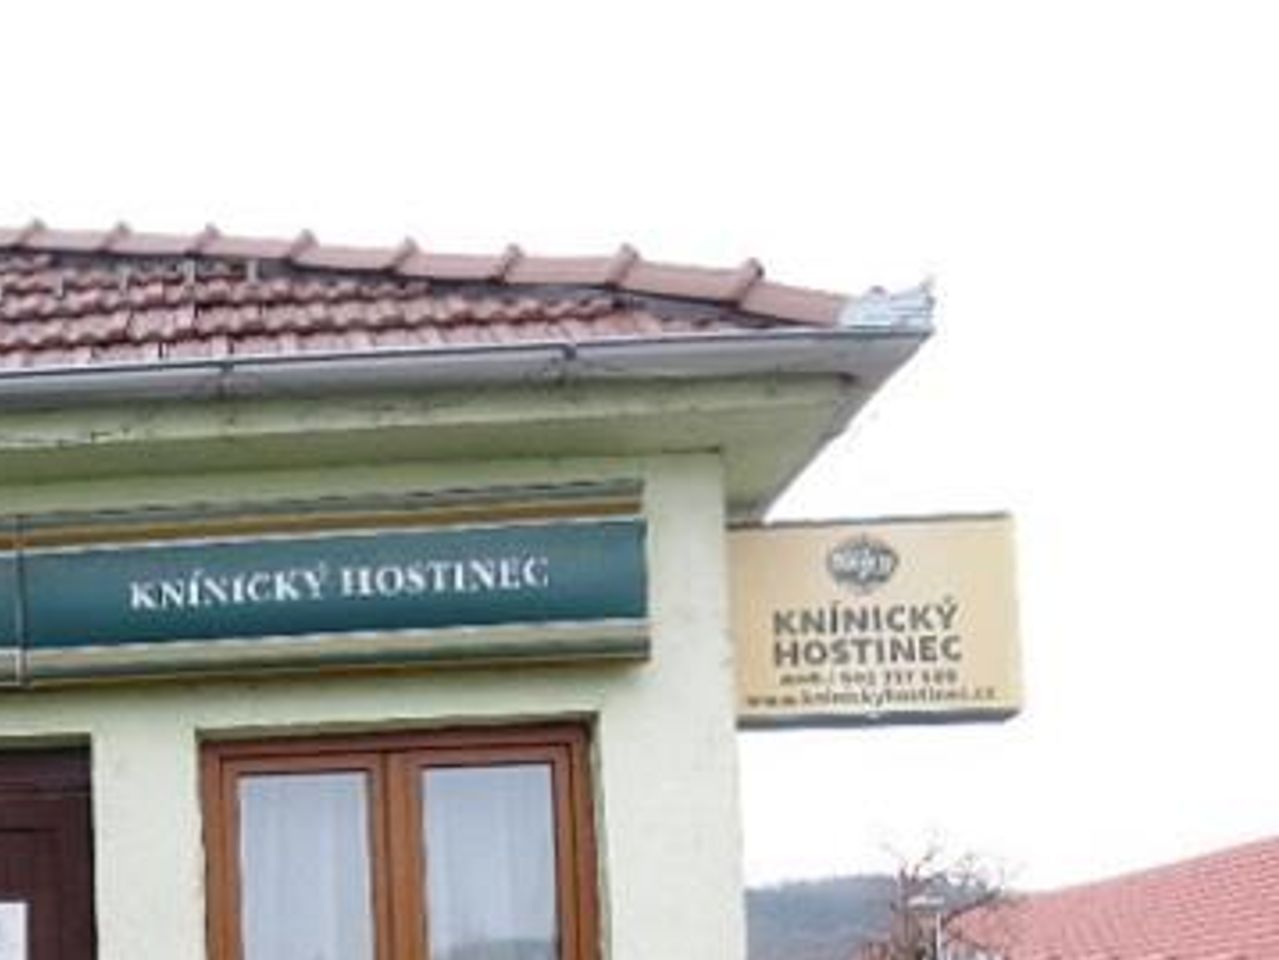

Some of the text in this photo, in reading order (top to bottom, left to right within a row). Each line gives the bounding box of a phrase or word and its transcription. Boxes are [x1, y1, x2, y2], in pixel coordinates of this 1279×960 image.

[129, 556, 549, 610] KNÍNICKÝ HOSTINEC
[773, 595, 959, 636] KNÍNICKÝ
[774, 635, 963, 668] HOSTINEC
